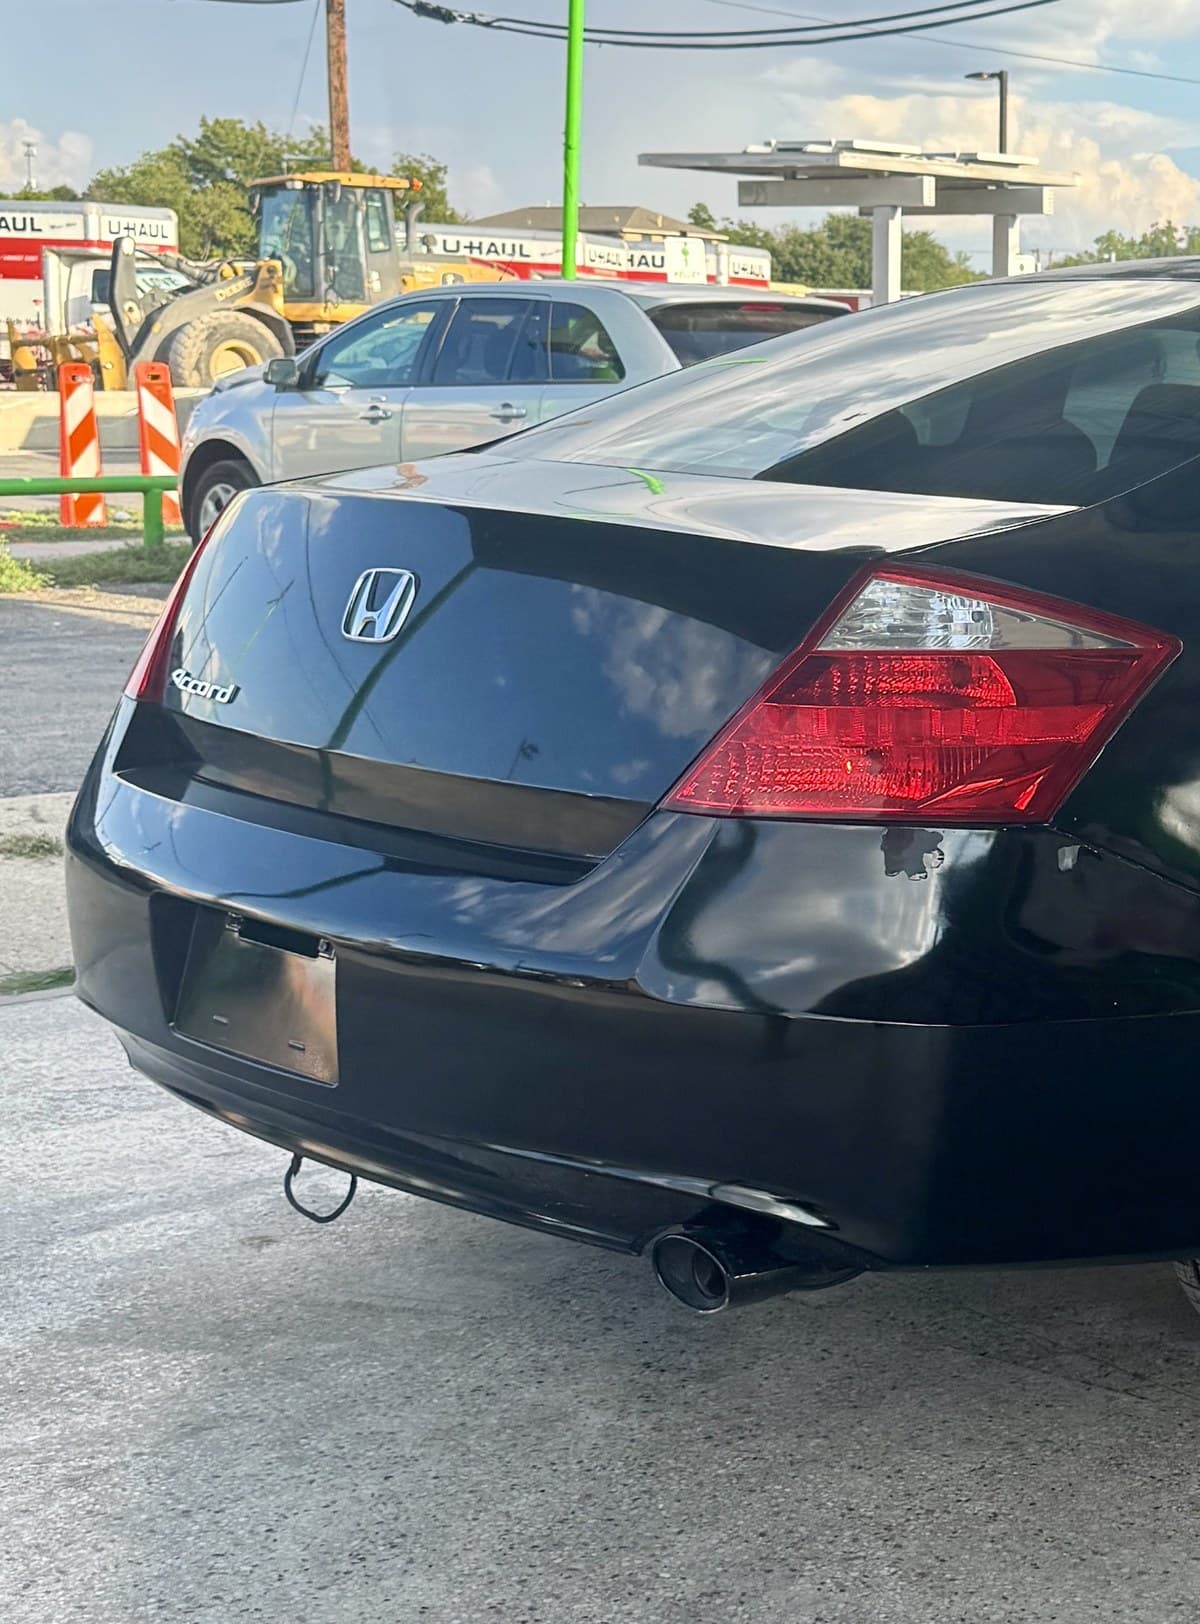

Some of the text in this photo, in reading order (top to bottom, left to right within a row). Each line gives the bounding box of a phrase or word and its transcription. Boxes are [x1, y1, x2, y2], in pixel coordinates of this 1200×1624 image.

[108, 220, 169, 239] U-HAUL
[443, 239, 530, 258] U-HAUL
[171, 668, 238, 704] Accord
